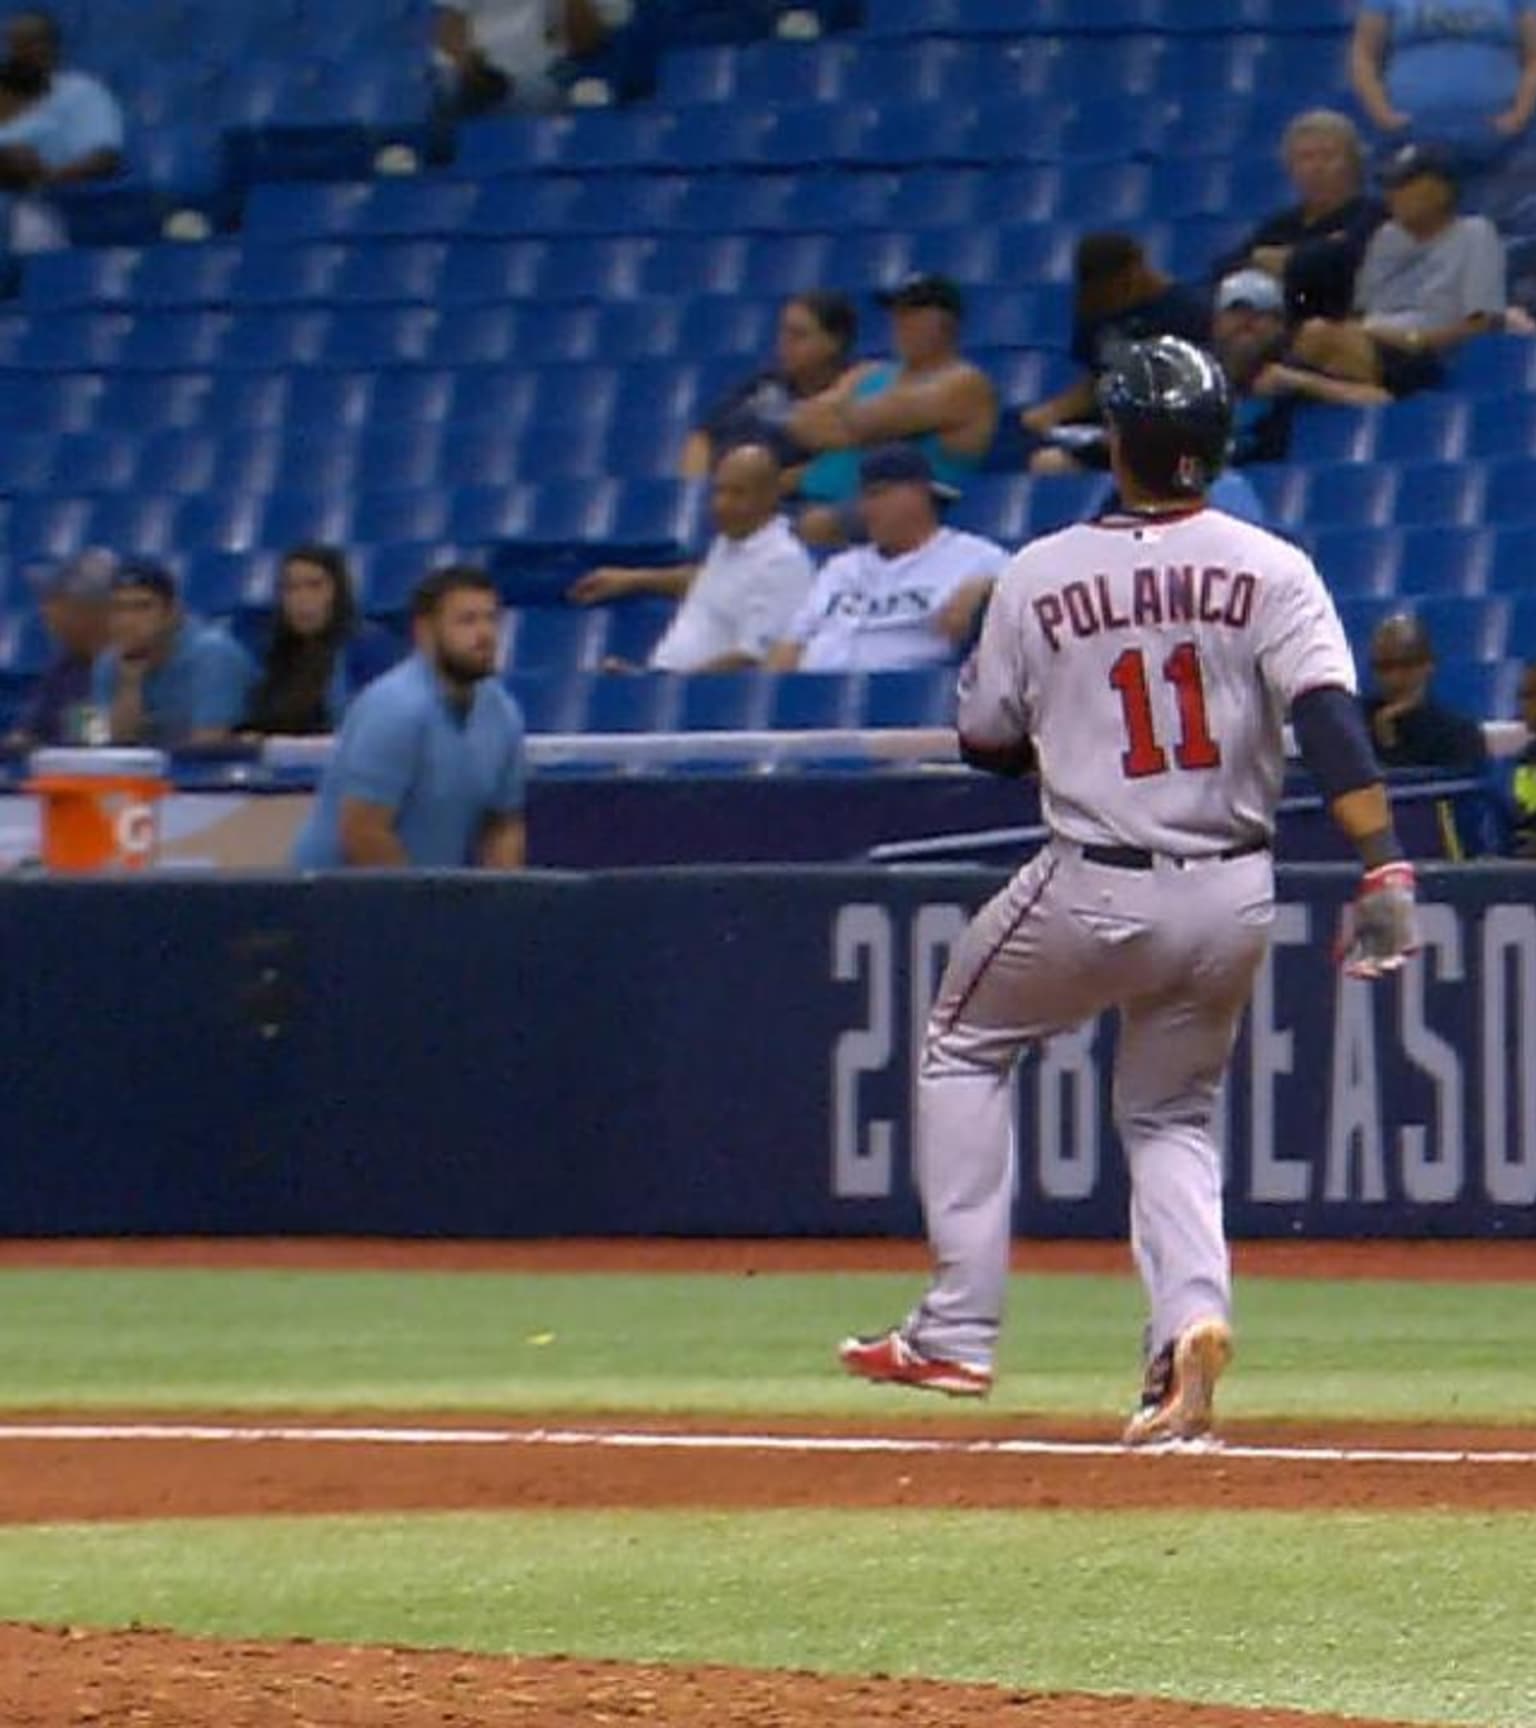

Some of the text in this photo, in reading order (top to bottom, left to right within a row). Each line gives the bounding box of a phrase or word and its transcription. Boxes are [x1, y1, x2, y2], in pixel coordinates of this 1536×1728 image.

[1033, 564, 1256, 653] POLANCO
[1108, 641, 1221, 778] 11
[829, 902, 1101, 1201] 28
